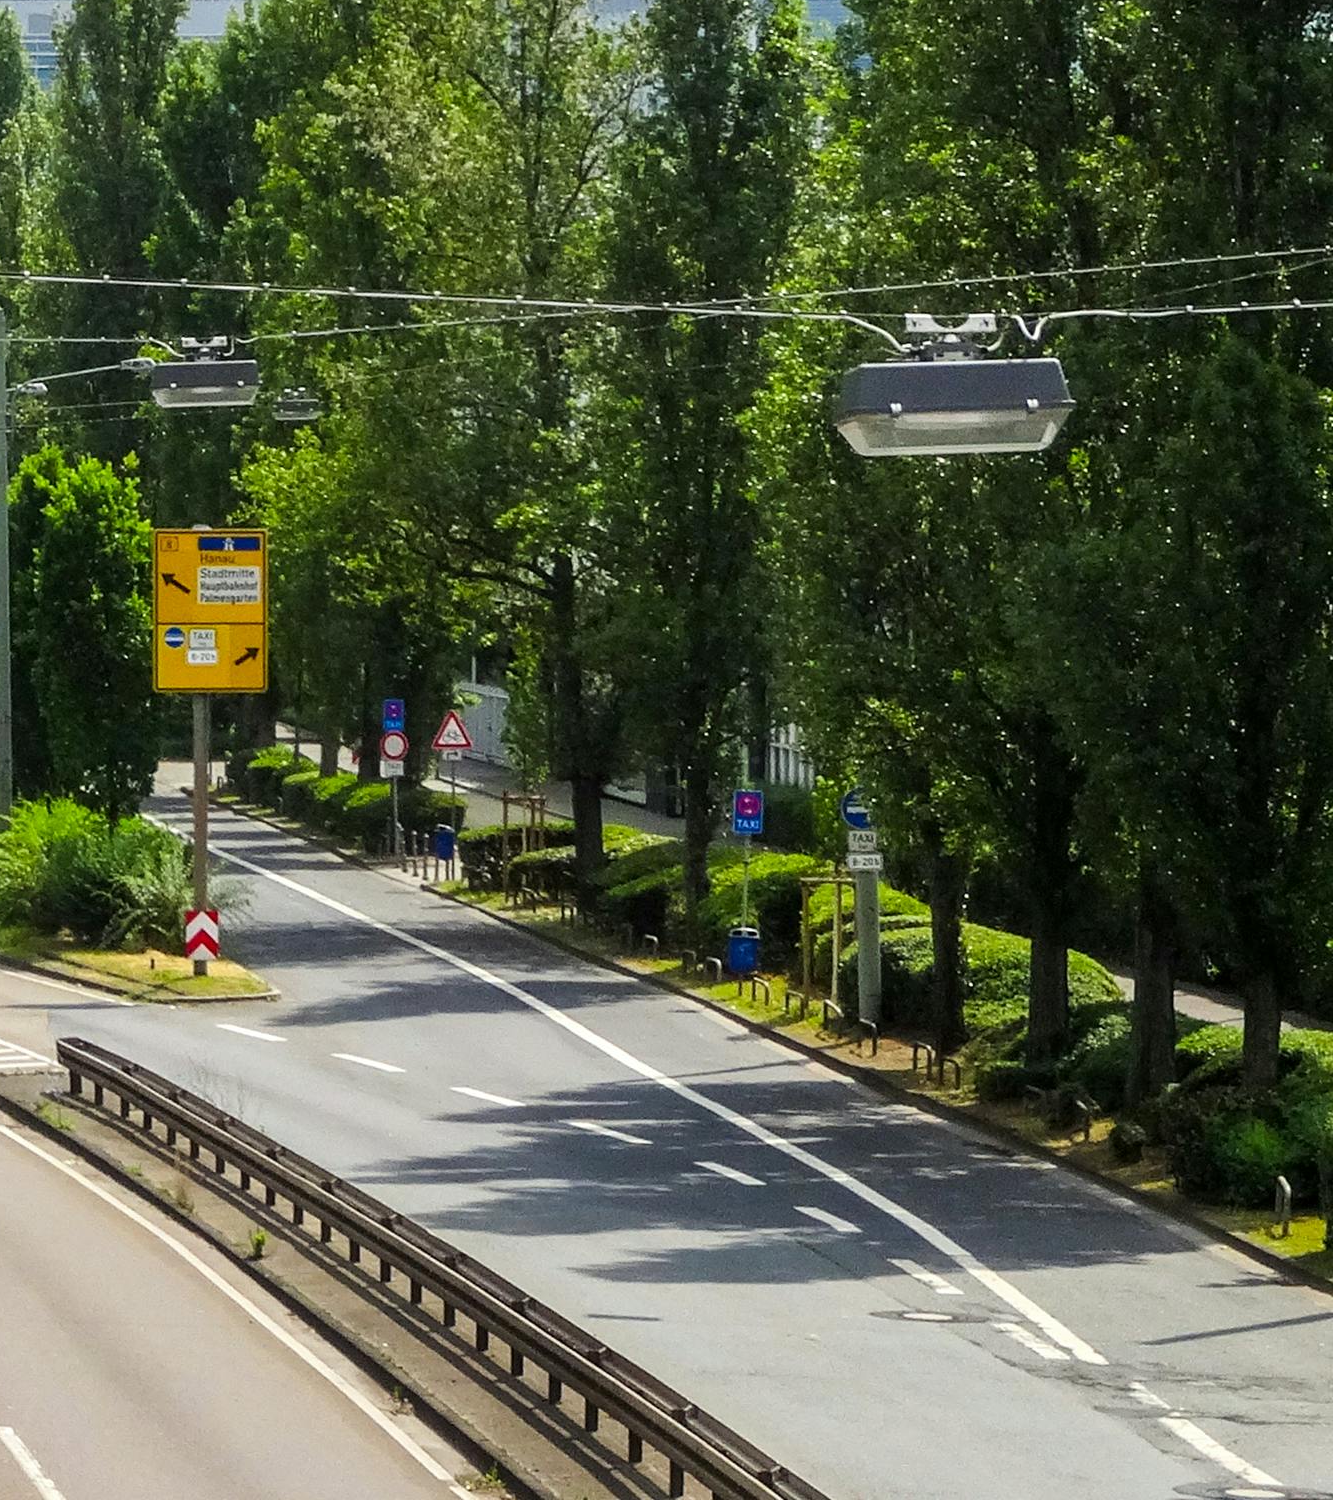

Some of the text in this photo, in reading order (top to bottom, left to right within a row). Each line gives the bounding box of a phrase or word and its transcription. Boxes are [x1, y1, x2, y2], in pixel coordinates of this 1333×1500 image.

[199, 553, 236, 564] Hanau
[199, 567, 255, 579] Stadtmitte
[199, 580, 258, 592] Hauptbahnhof
[199, 593, 258, 605] Palmengarten
[193, 631, 213, 639] TAXI
[736, 819, 760, 829] TAXI
[852, 832, 875, 843] TAXI
